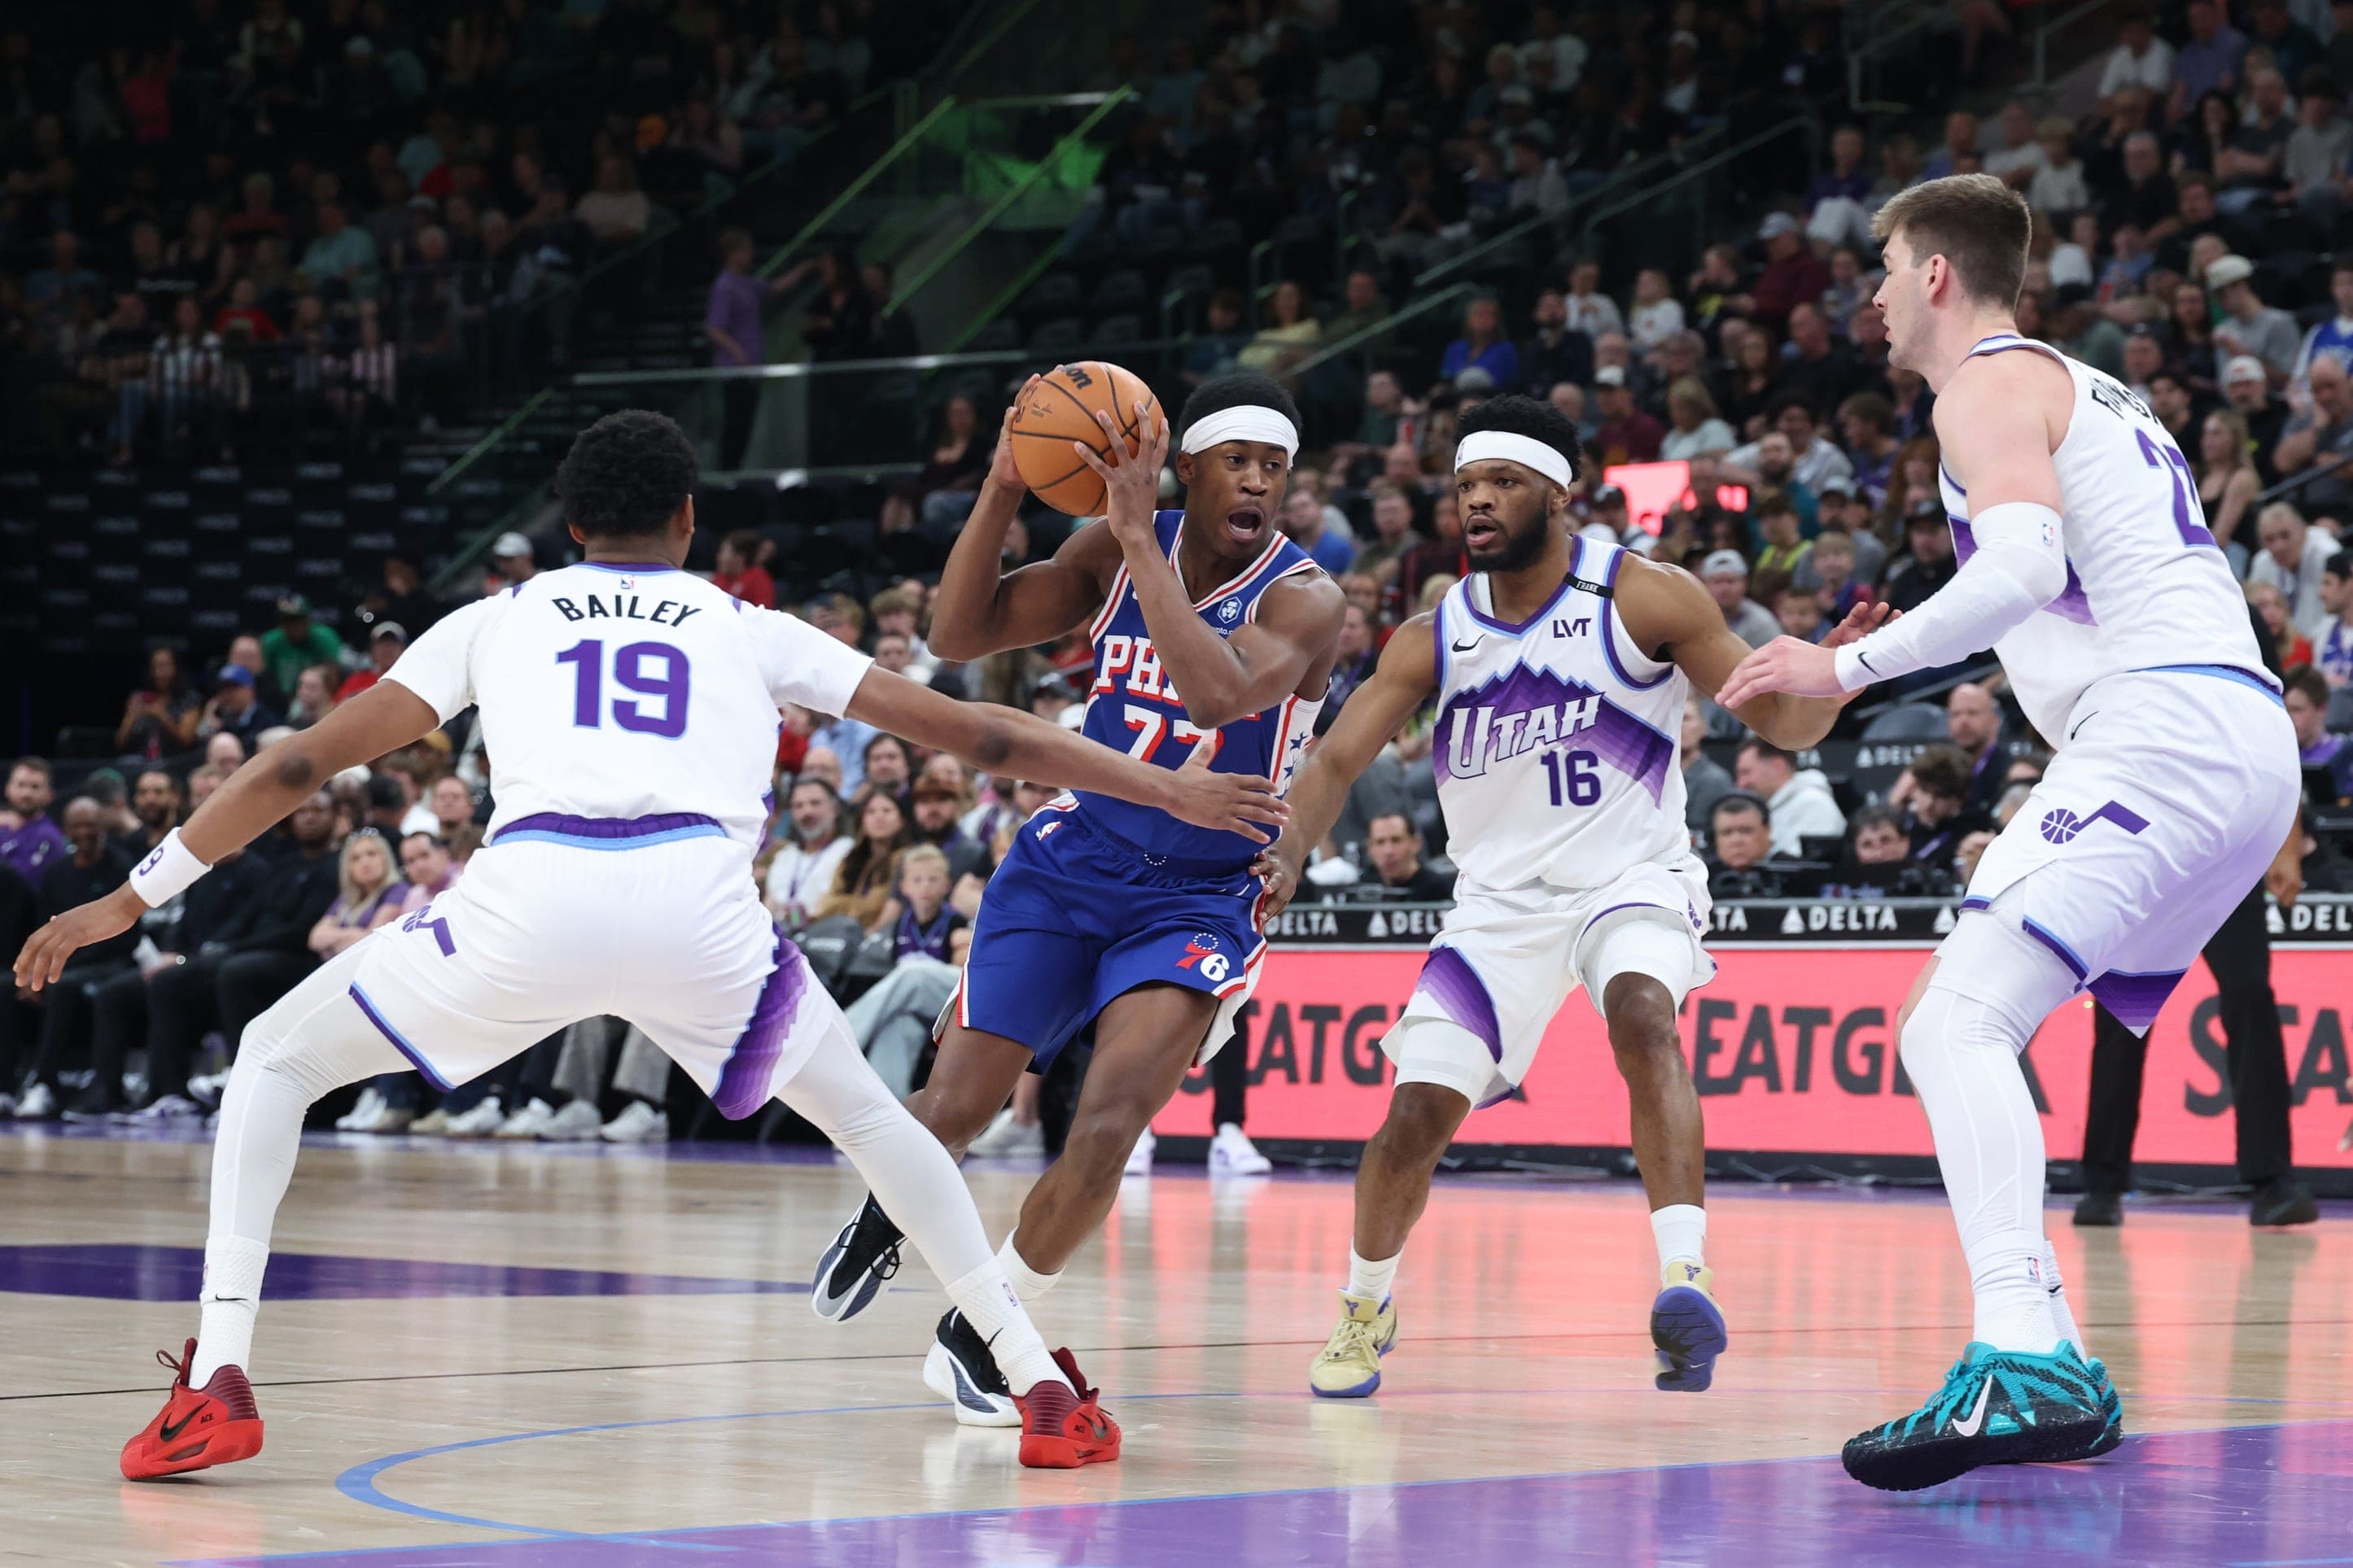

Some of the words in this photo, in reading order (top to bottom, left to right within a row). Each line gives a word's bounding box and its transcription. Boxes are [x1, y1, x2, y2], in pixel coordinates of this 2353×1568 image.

[552, 594, 702, 627] BAILEY
[1553, 618, 1592, 638] LVT
[555, 638, 691, 740] 19
[1124, 703, 1224, 769] 77
[1447, 692, 1606, 780] UTAH
[1541, 749, 1601, 806] 16
[1390, 910, 1445, 936] DEL
[1808, 905, 1898, 932] DELTA
[2291, 903, 2353, 932] DEL
[1174, 940, 1230, 981] 76
[200, 1413, 215, 1424] ACE
